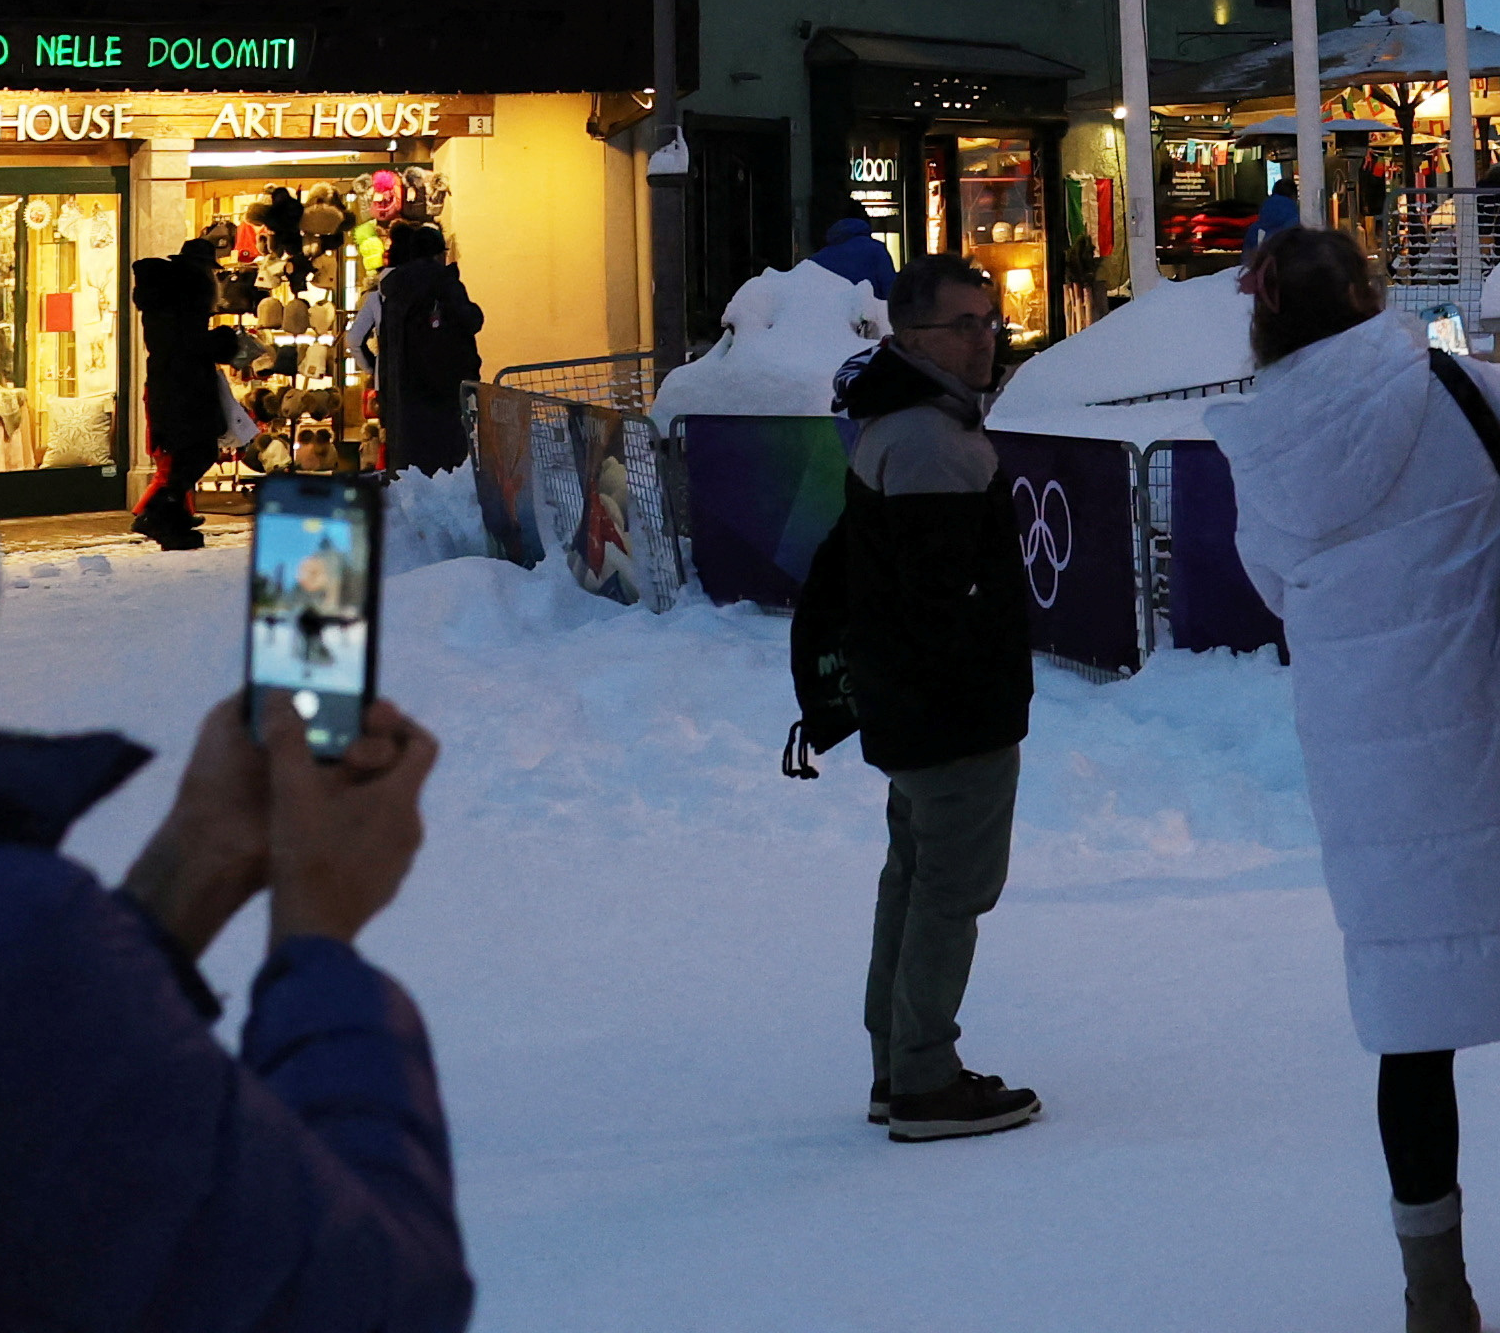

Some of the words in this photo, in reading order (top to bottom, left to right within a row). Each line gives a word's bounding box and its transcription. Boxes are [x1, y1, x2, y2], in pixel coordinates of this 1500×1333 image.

[36, 34, 122, 68] NELLE
[147, 37, 295, 70] DOLOMITI
[207, 101, 292, 139] ART
[312, 101, 440, 138] HOUSE
[477, 118, 484, 129] 3
